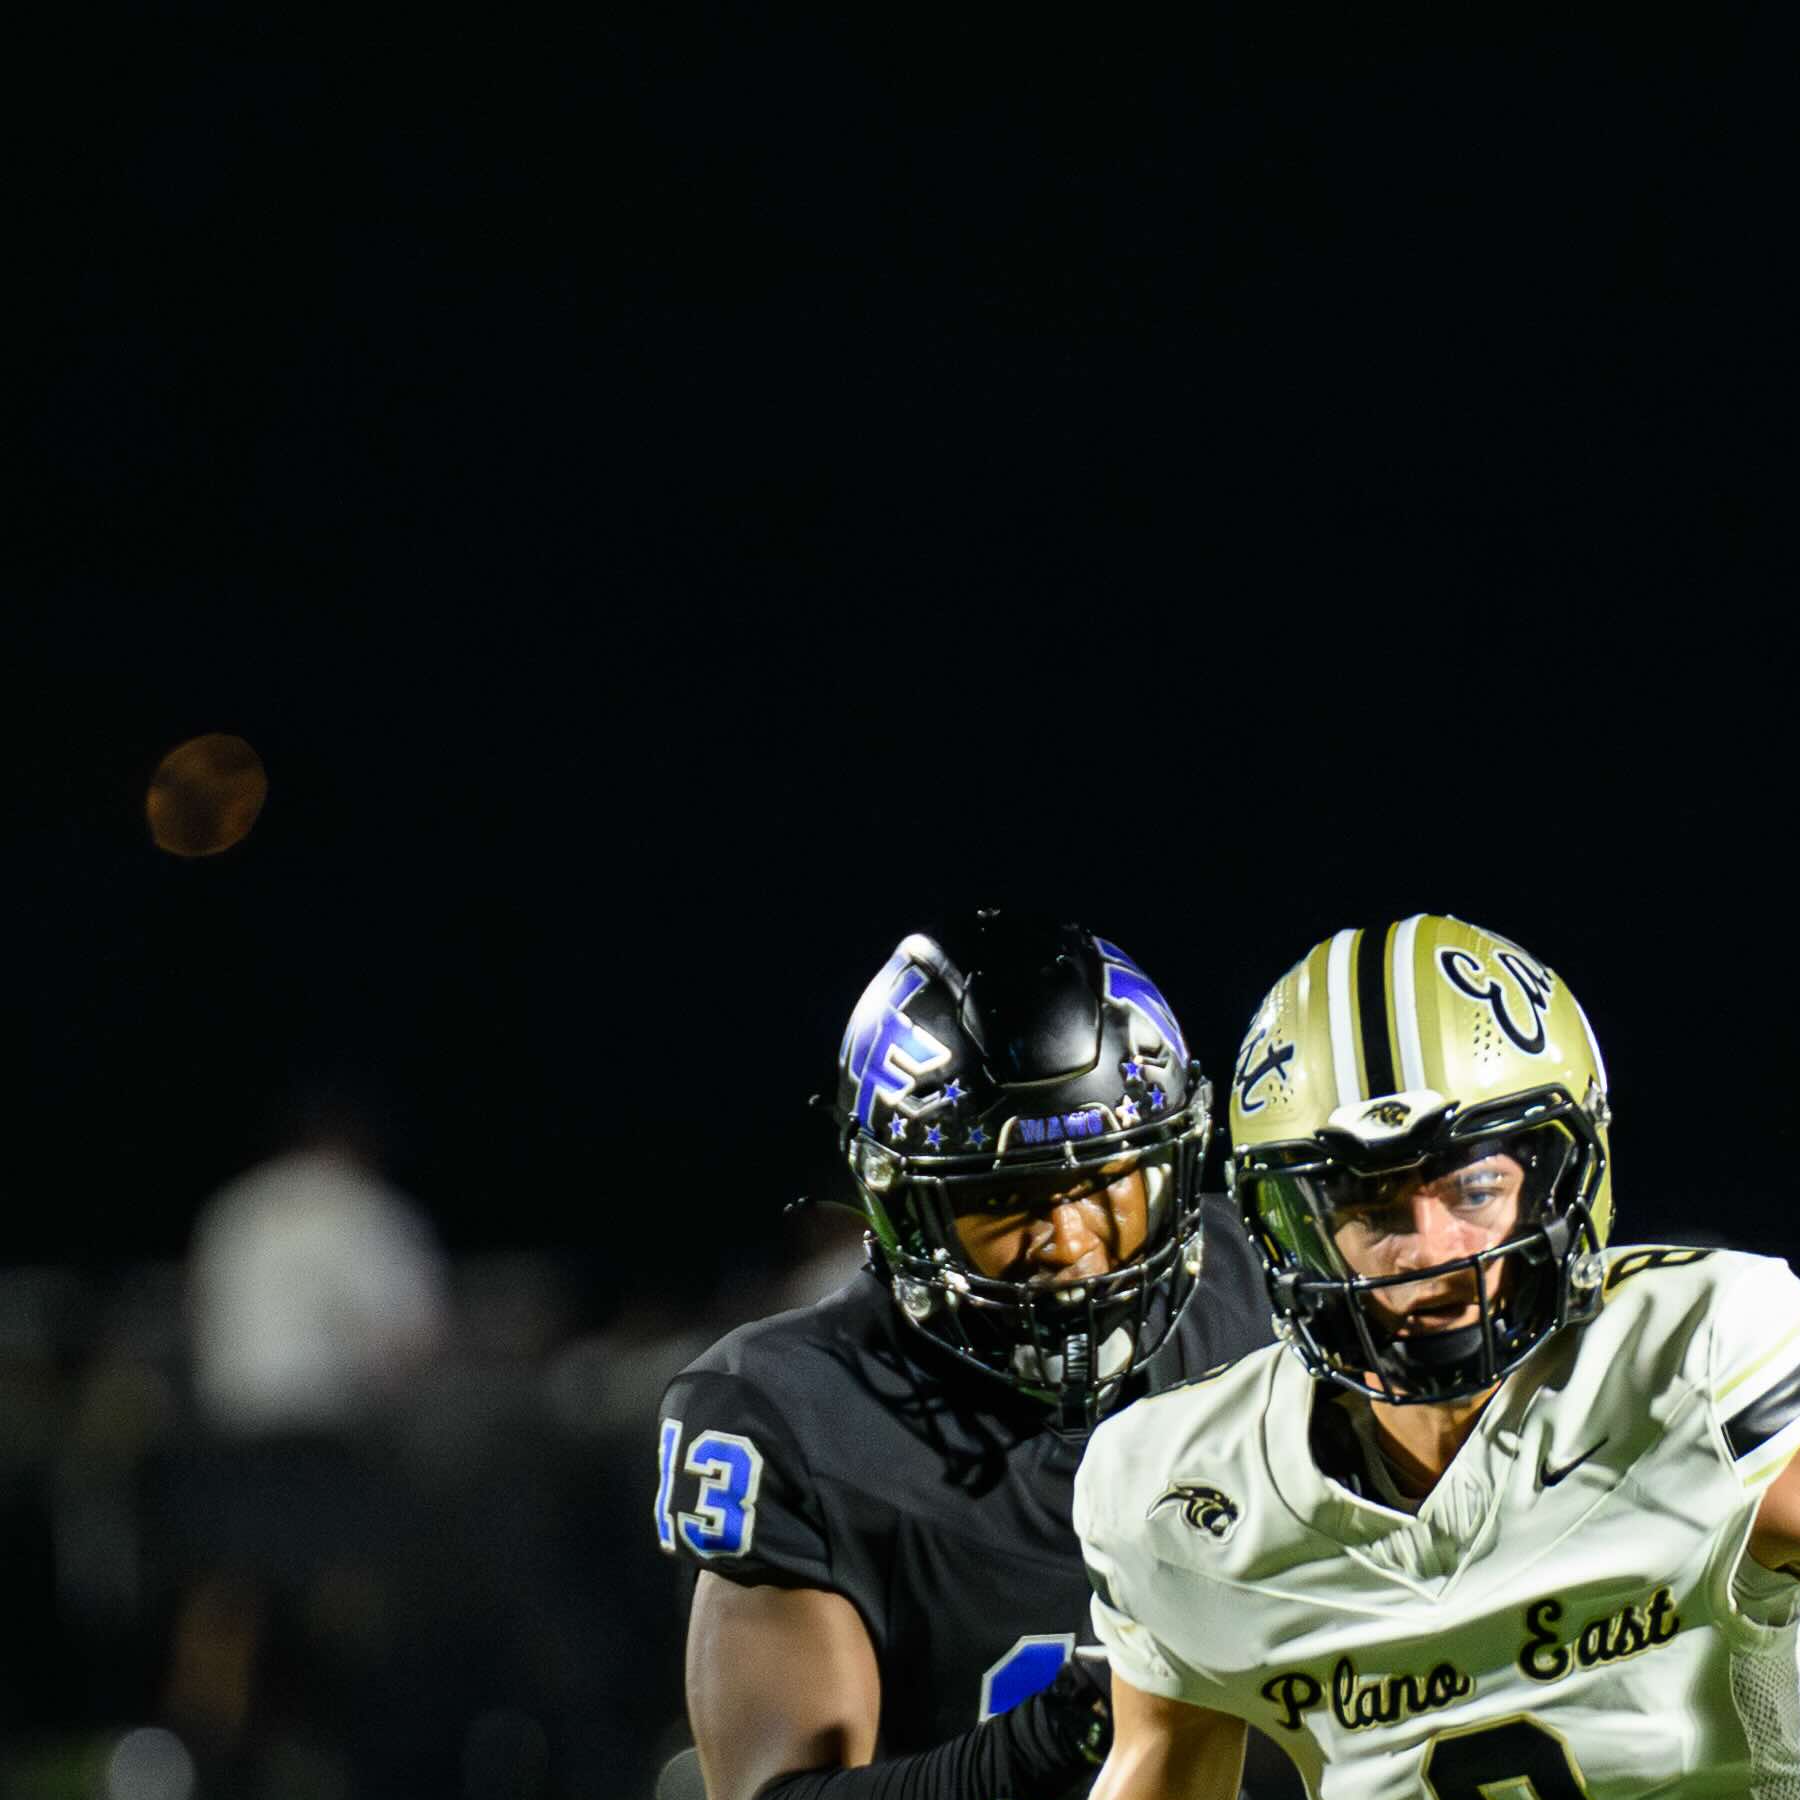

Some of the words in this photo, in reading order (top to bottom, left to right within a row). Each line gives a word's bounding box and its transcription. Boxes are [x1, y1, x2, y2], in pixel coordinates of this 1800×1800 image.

[654, 1417, 764, 1559] 13
[1261, 1656, 1475, 1733] Plano
[1516, 1583, 1681, 1682] East
